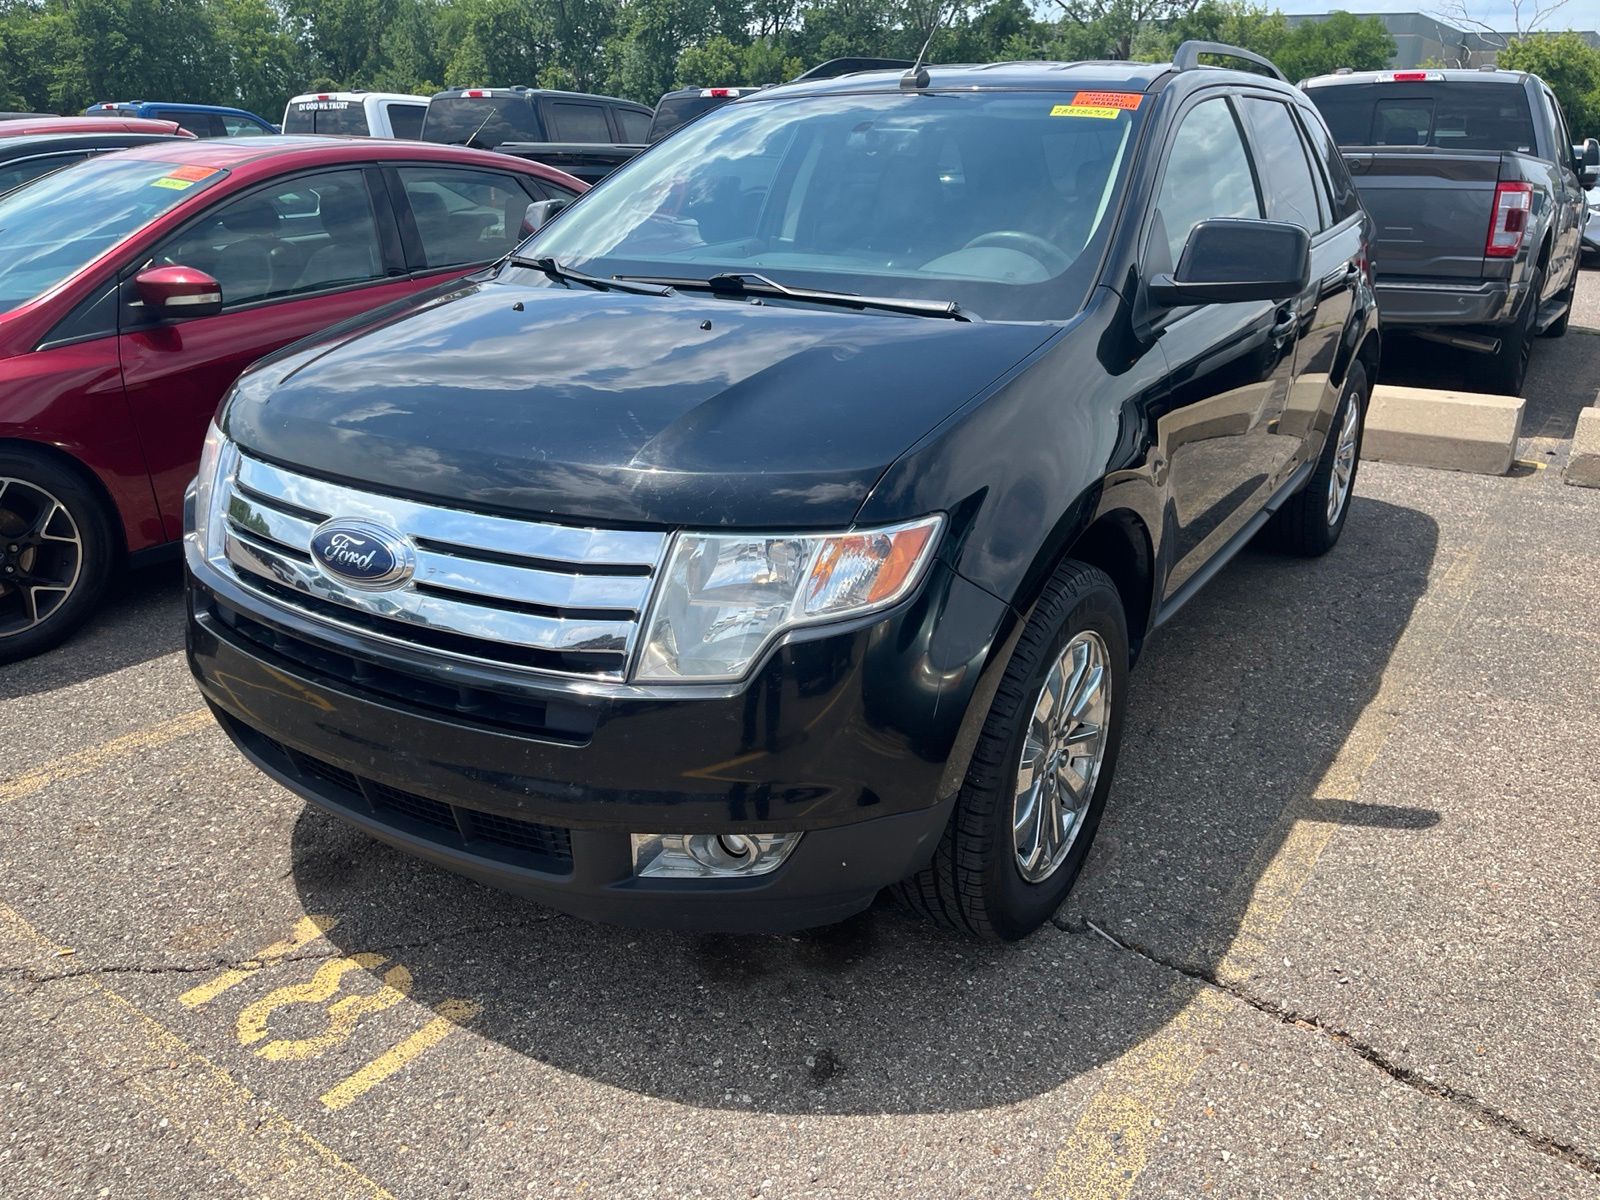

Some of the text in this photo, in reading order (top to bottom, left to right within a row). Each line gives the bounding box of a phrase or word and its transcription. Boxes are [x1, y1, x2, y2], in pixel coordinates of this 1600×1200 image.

[299, 101, 349, 111] IN GOD WE TRUST
[1092, 101, 1136, 109] MANAGER
[324, 533, 377, 568] Ford
